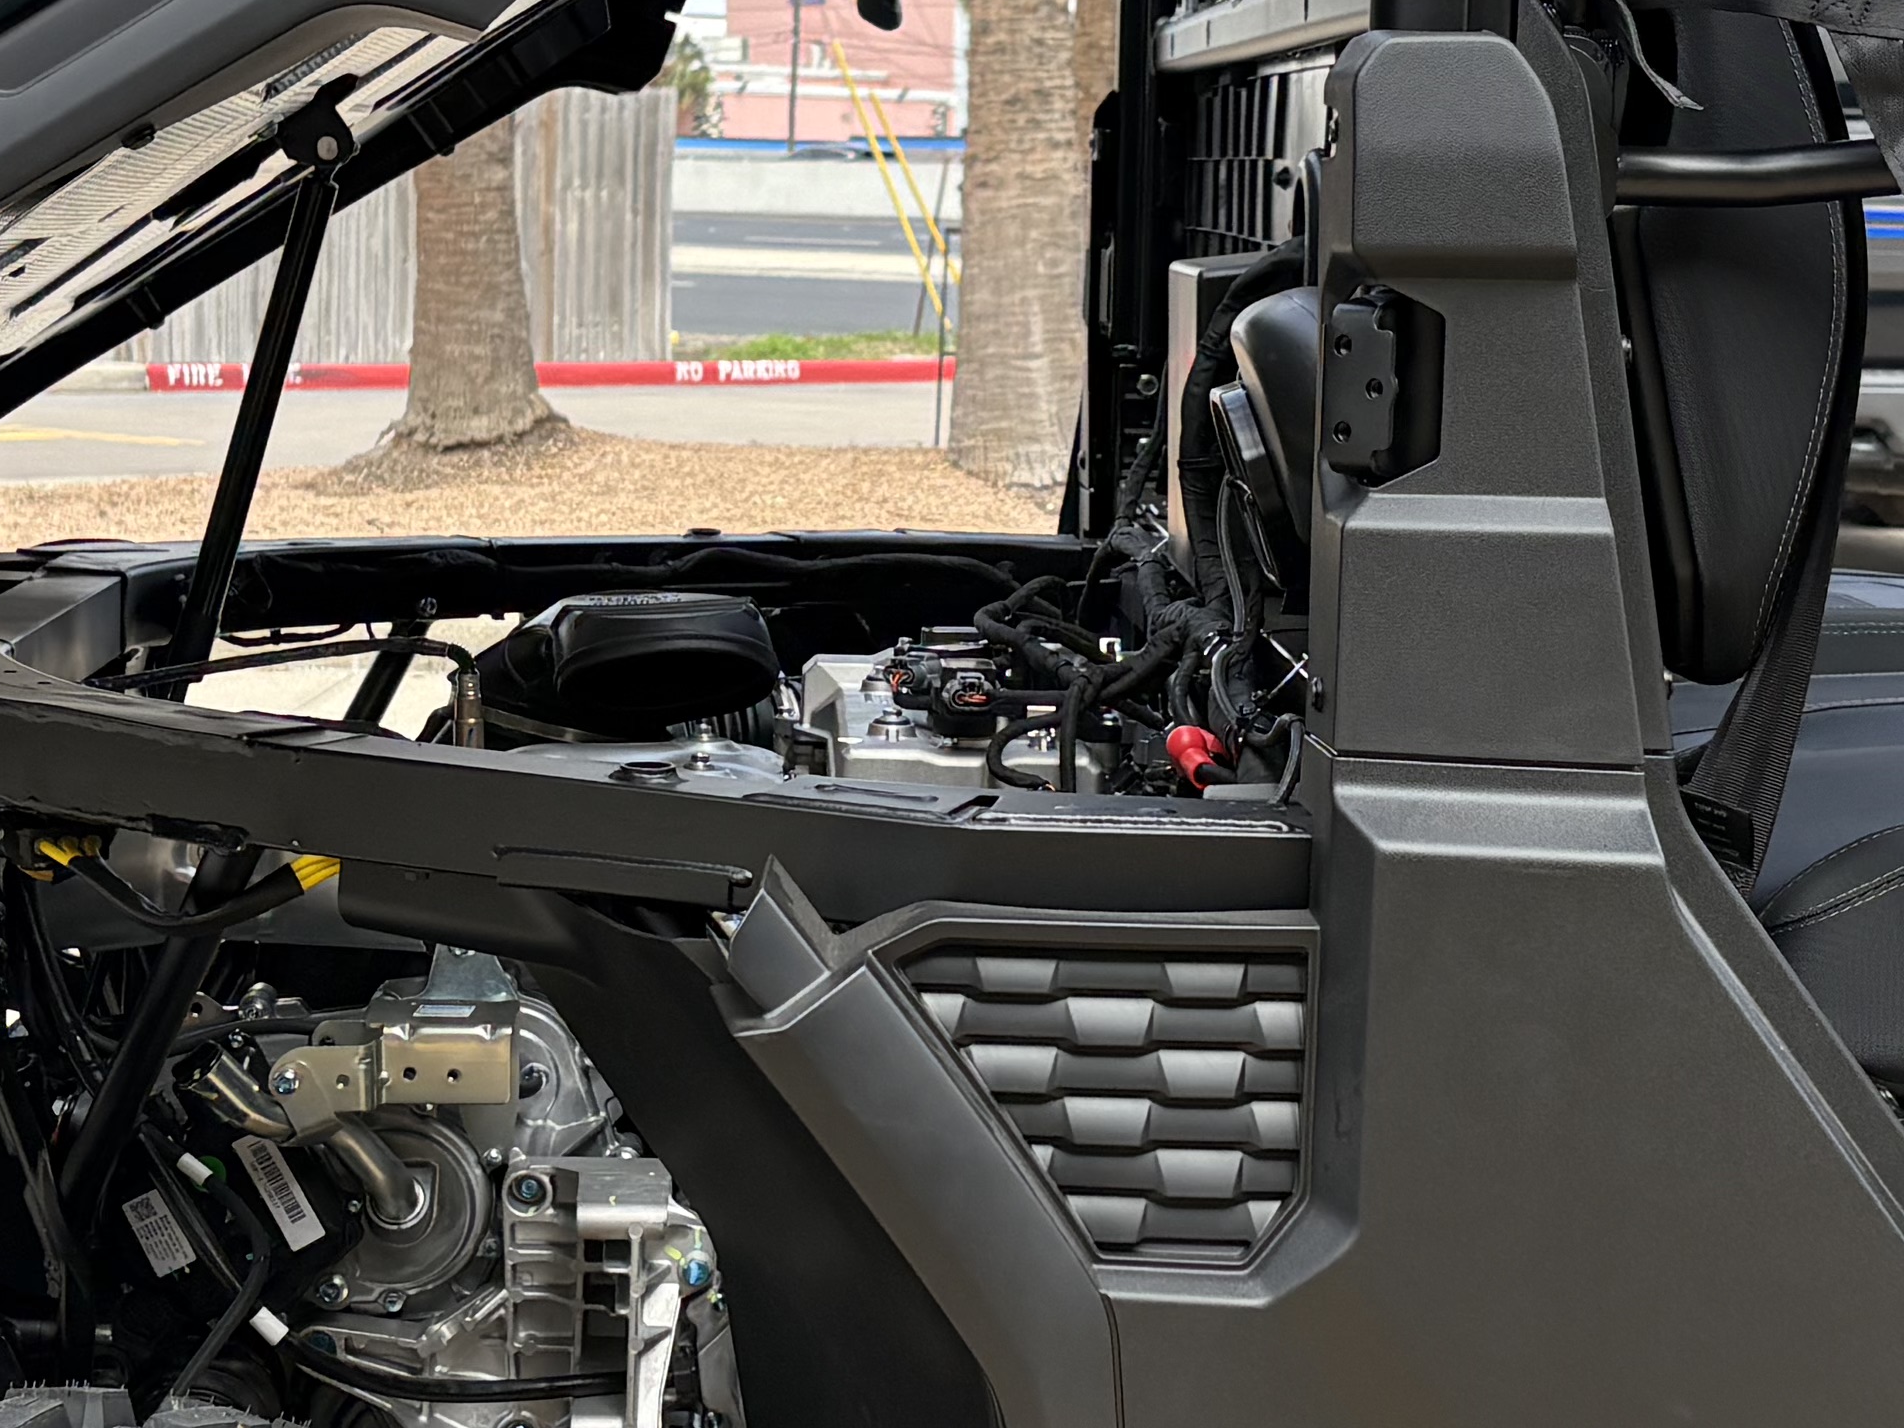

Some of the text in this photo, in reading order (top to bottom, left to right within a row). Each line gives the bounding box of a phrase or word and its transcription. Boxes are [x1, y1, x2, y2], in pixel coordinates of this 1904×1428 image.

[167, 363, 223, 387] FIRE
[675, 360, 801, 382] NO PARKING
